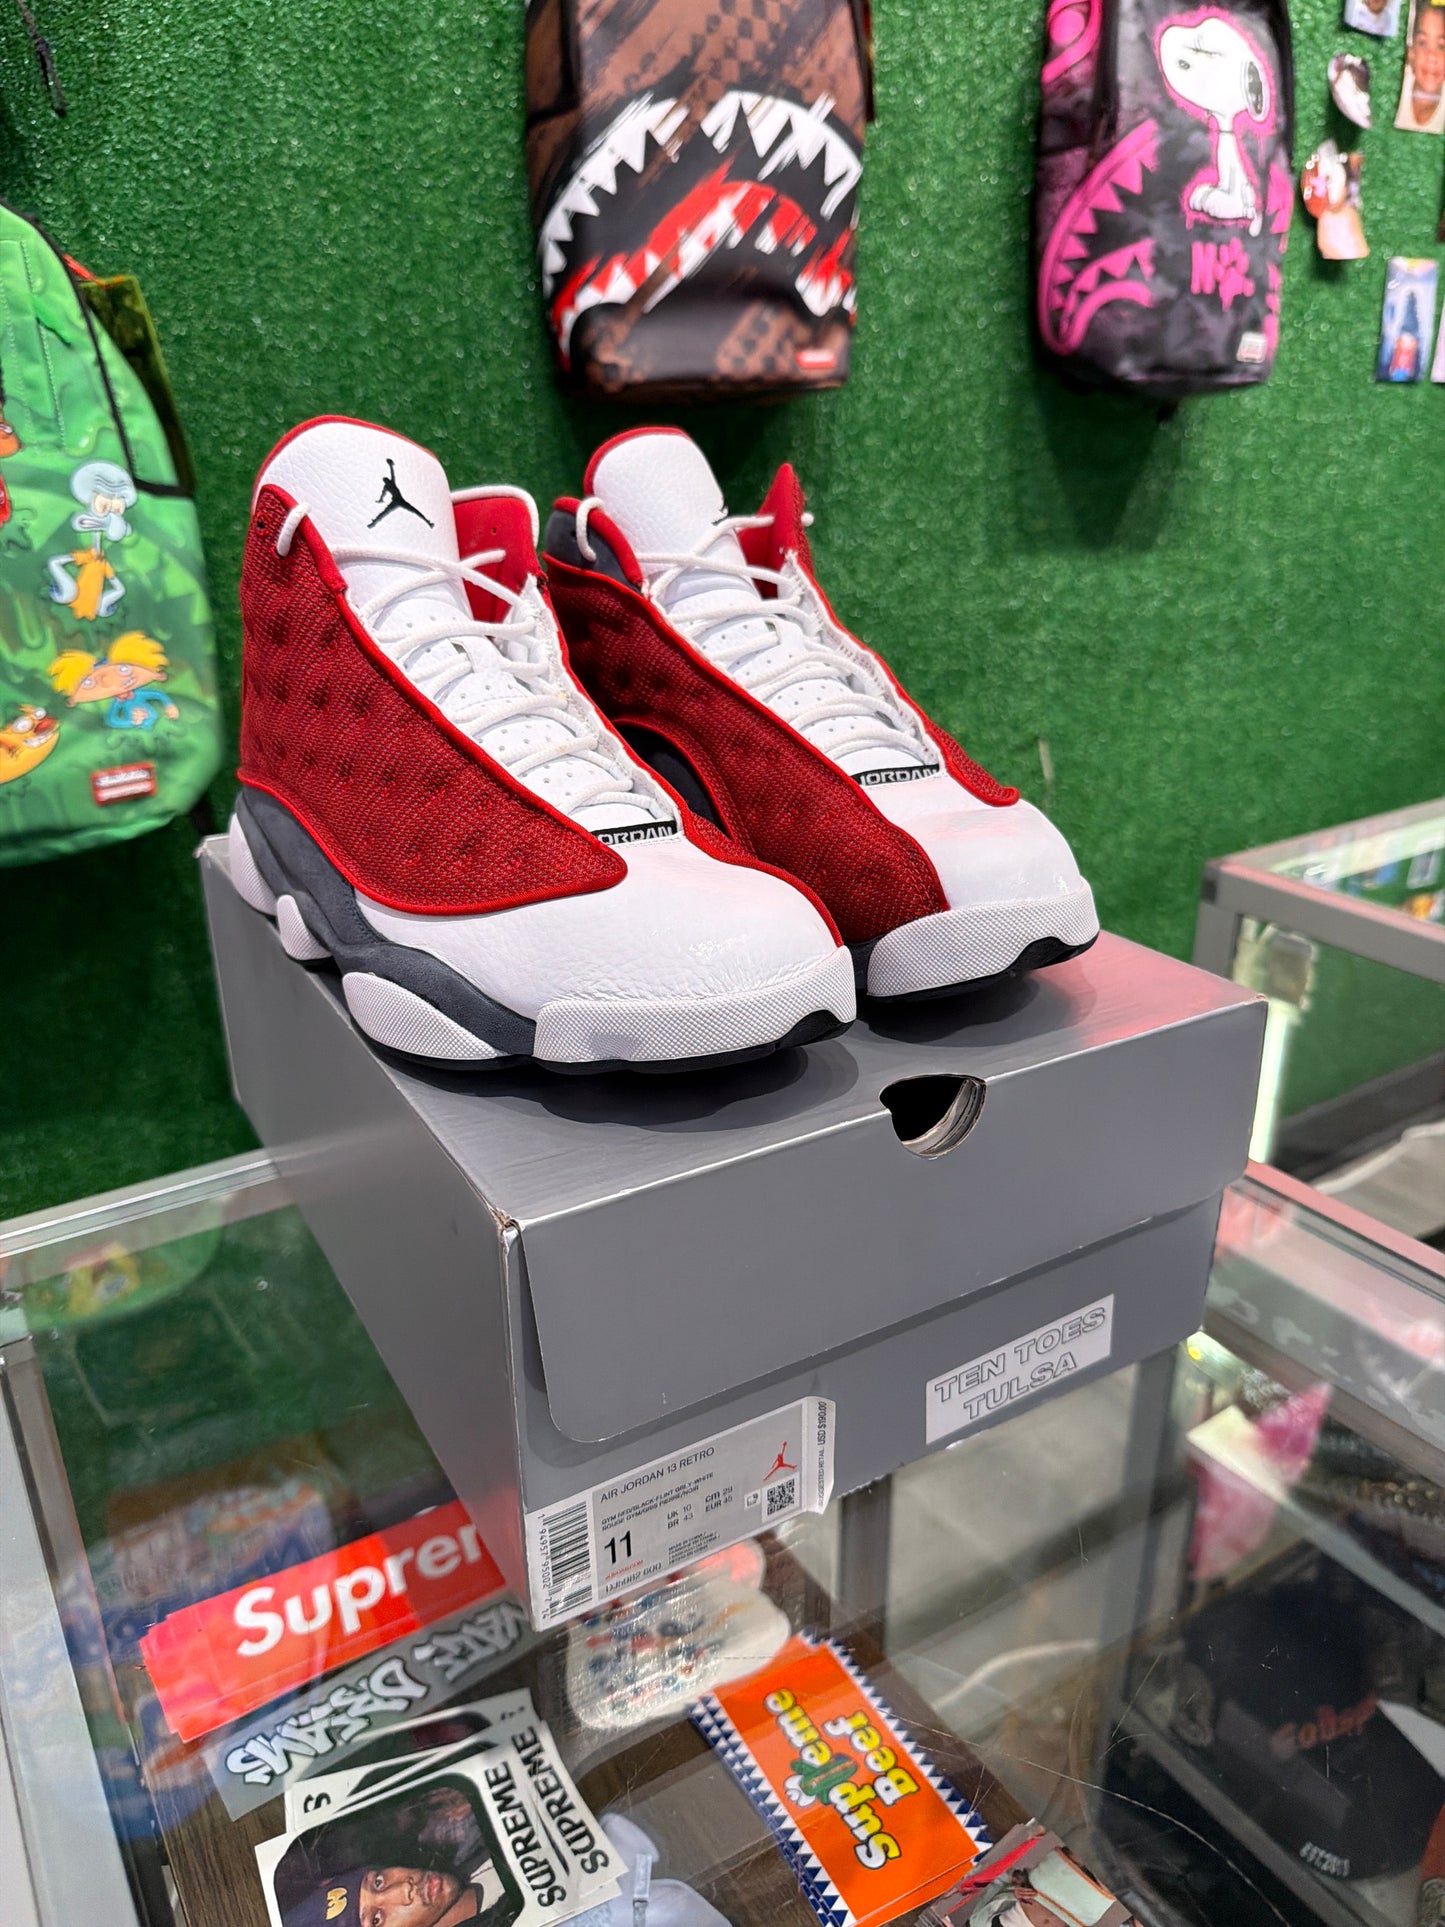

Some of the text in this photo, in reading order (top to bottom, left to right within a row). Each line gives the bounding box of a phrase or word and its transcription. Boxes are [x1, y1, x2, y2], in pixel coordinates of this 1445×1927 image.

[598, 826, 674, 846] ORDAN
[935, 1307, 1106, 1402] TEN TOES
[963, 1352, 1077, 1420] TULSA
[818, 1401, 827, 1429] $190.00
[817, 1430, 826, 1446] USD
[600, 1447, 715, 1504] AIR JORDAN 13 RETRO
[667, 1510, 679, 1521] UK
[683, 1503, 692, 1513] 10
[705, 1491, 721, 1503] cm
[683, 1512, 694, 1522] 43
[705, 1500, 722, 1512] EUR
[539, 1529, 549, 1557] 94957
[604, 1530, 632, 1565] 11
[542, 1561, 552, 1589] 95002
[823, 1710, 920, 1807] Beef
[764, 1688, 902, 1870] Supeme
[512, 1726, 610, 1874] SUPREME
[484, 1761, 567, 1908] SUPREME
